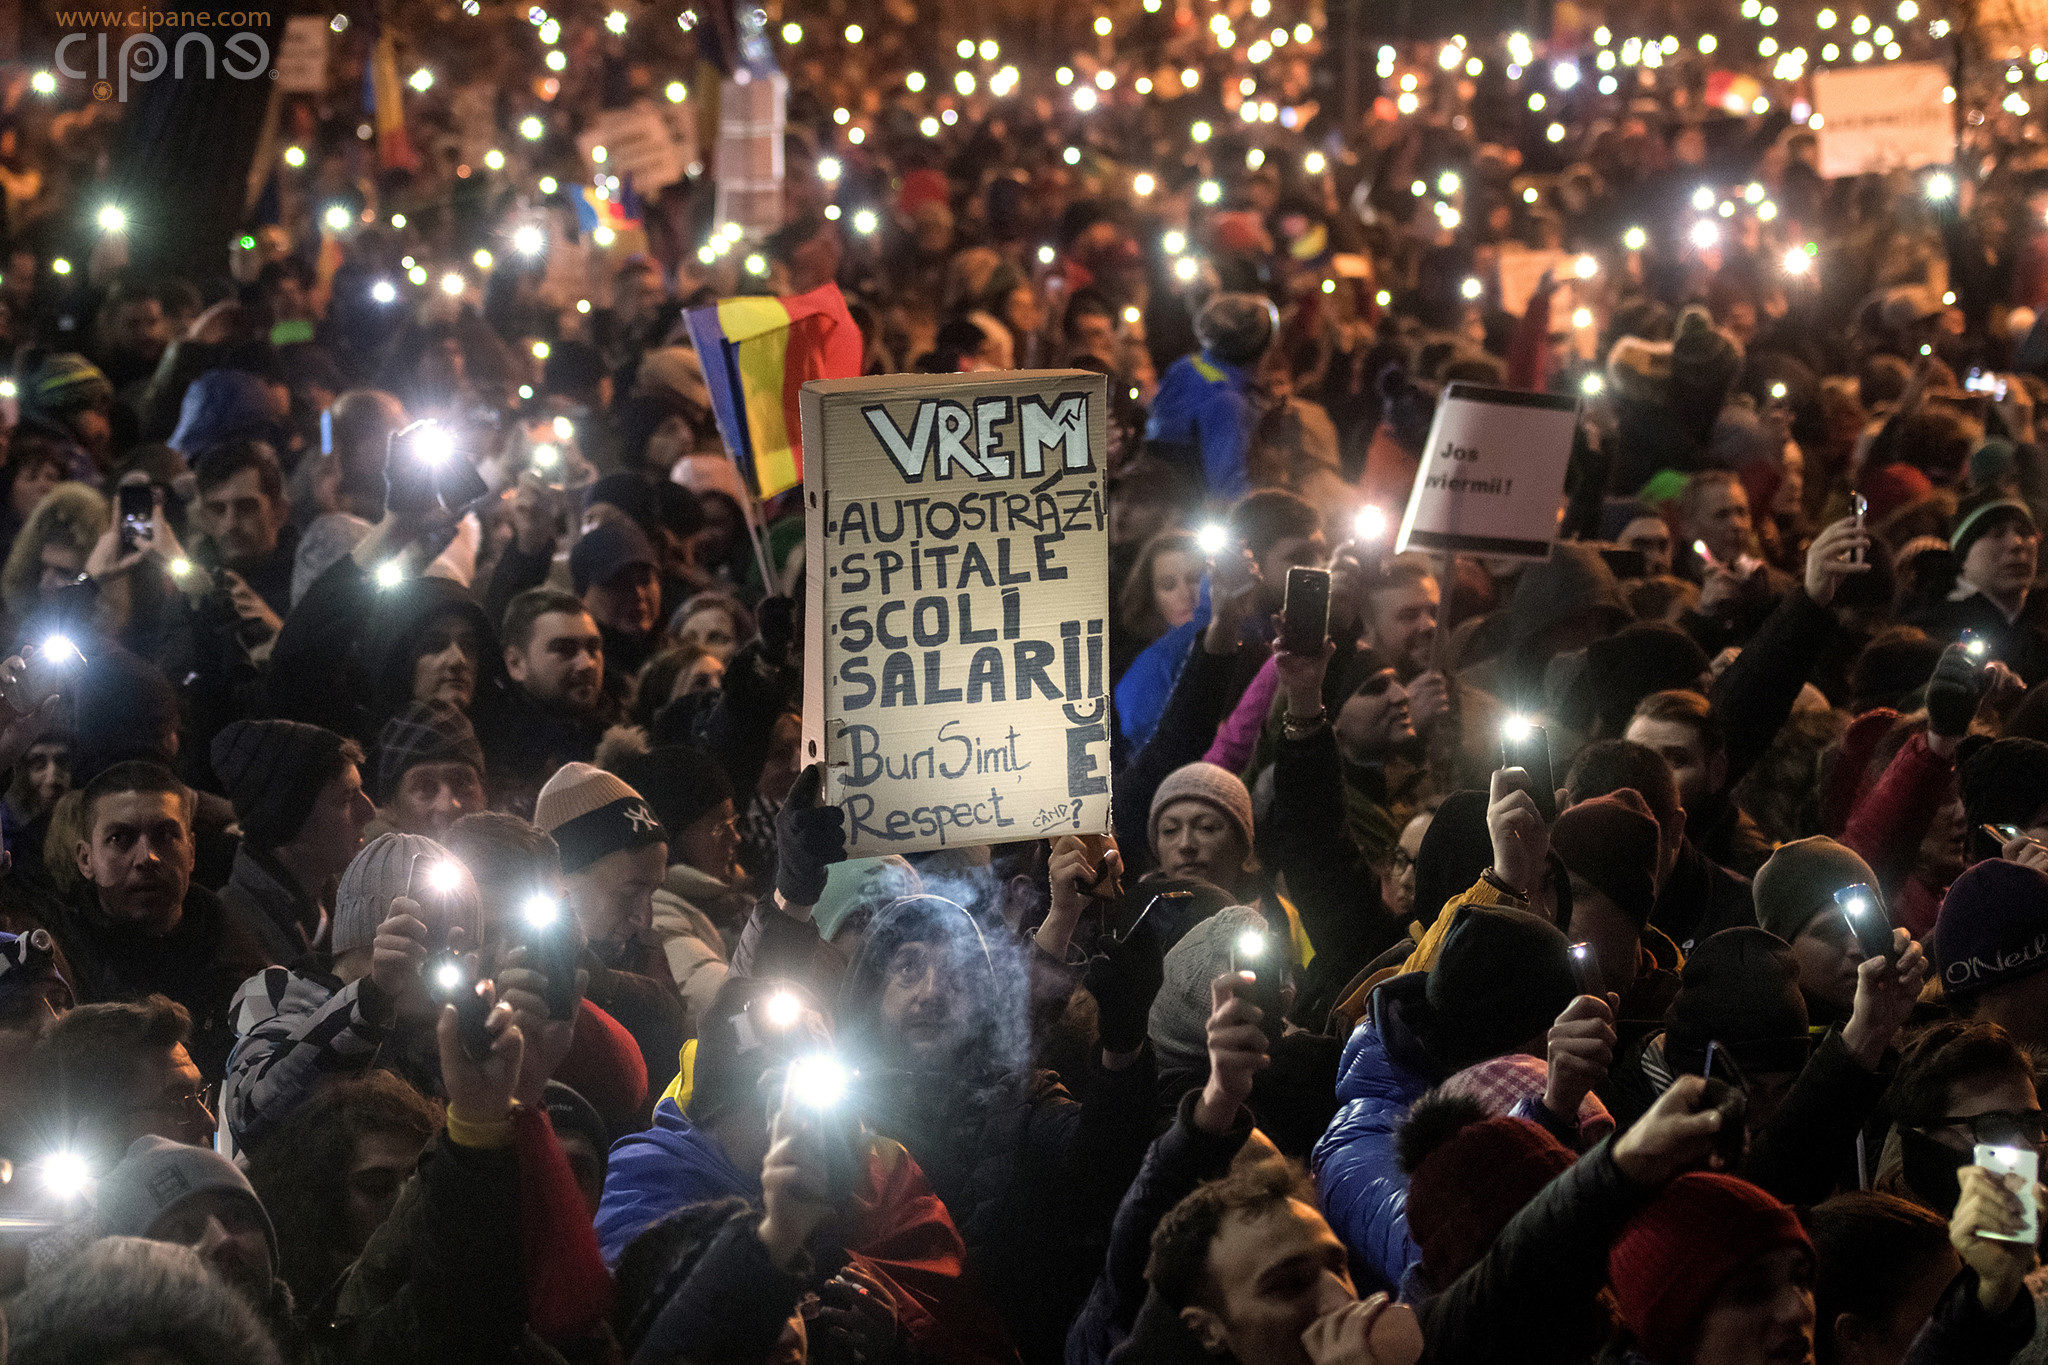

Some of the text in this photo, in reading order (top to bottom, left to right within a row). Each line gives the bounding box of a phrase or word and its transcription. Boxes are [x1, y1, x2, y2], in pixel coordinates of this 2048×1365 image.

[861, 391, 1097, 484] VREM
[1441, 442, 1479, 462] Jos
[841, 532, 1068, 594] SPITALE
[840, 586, 1021, 653] SCOLI
[840, 787, 1015, 846] Respect
